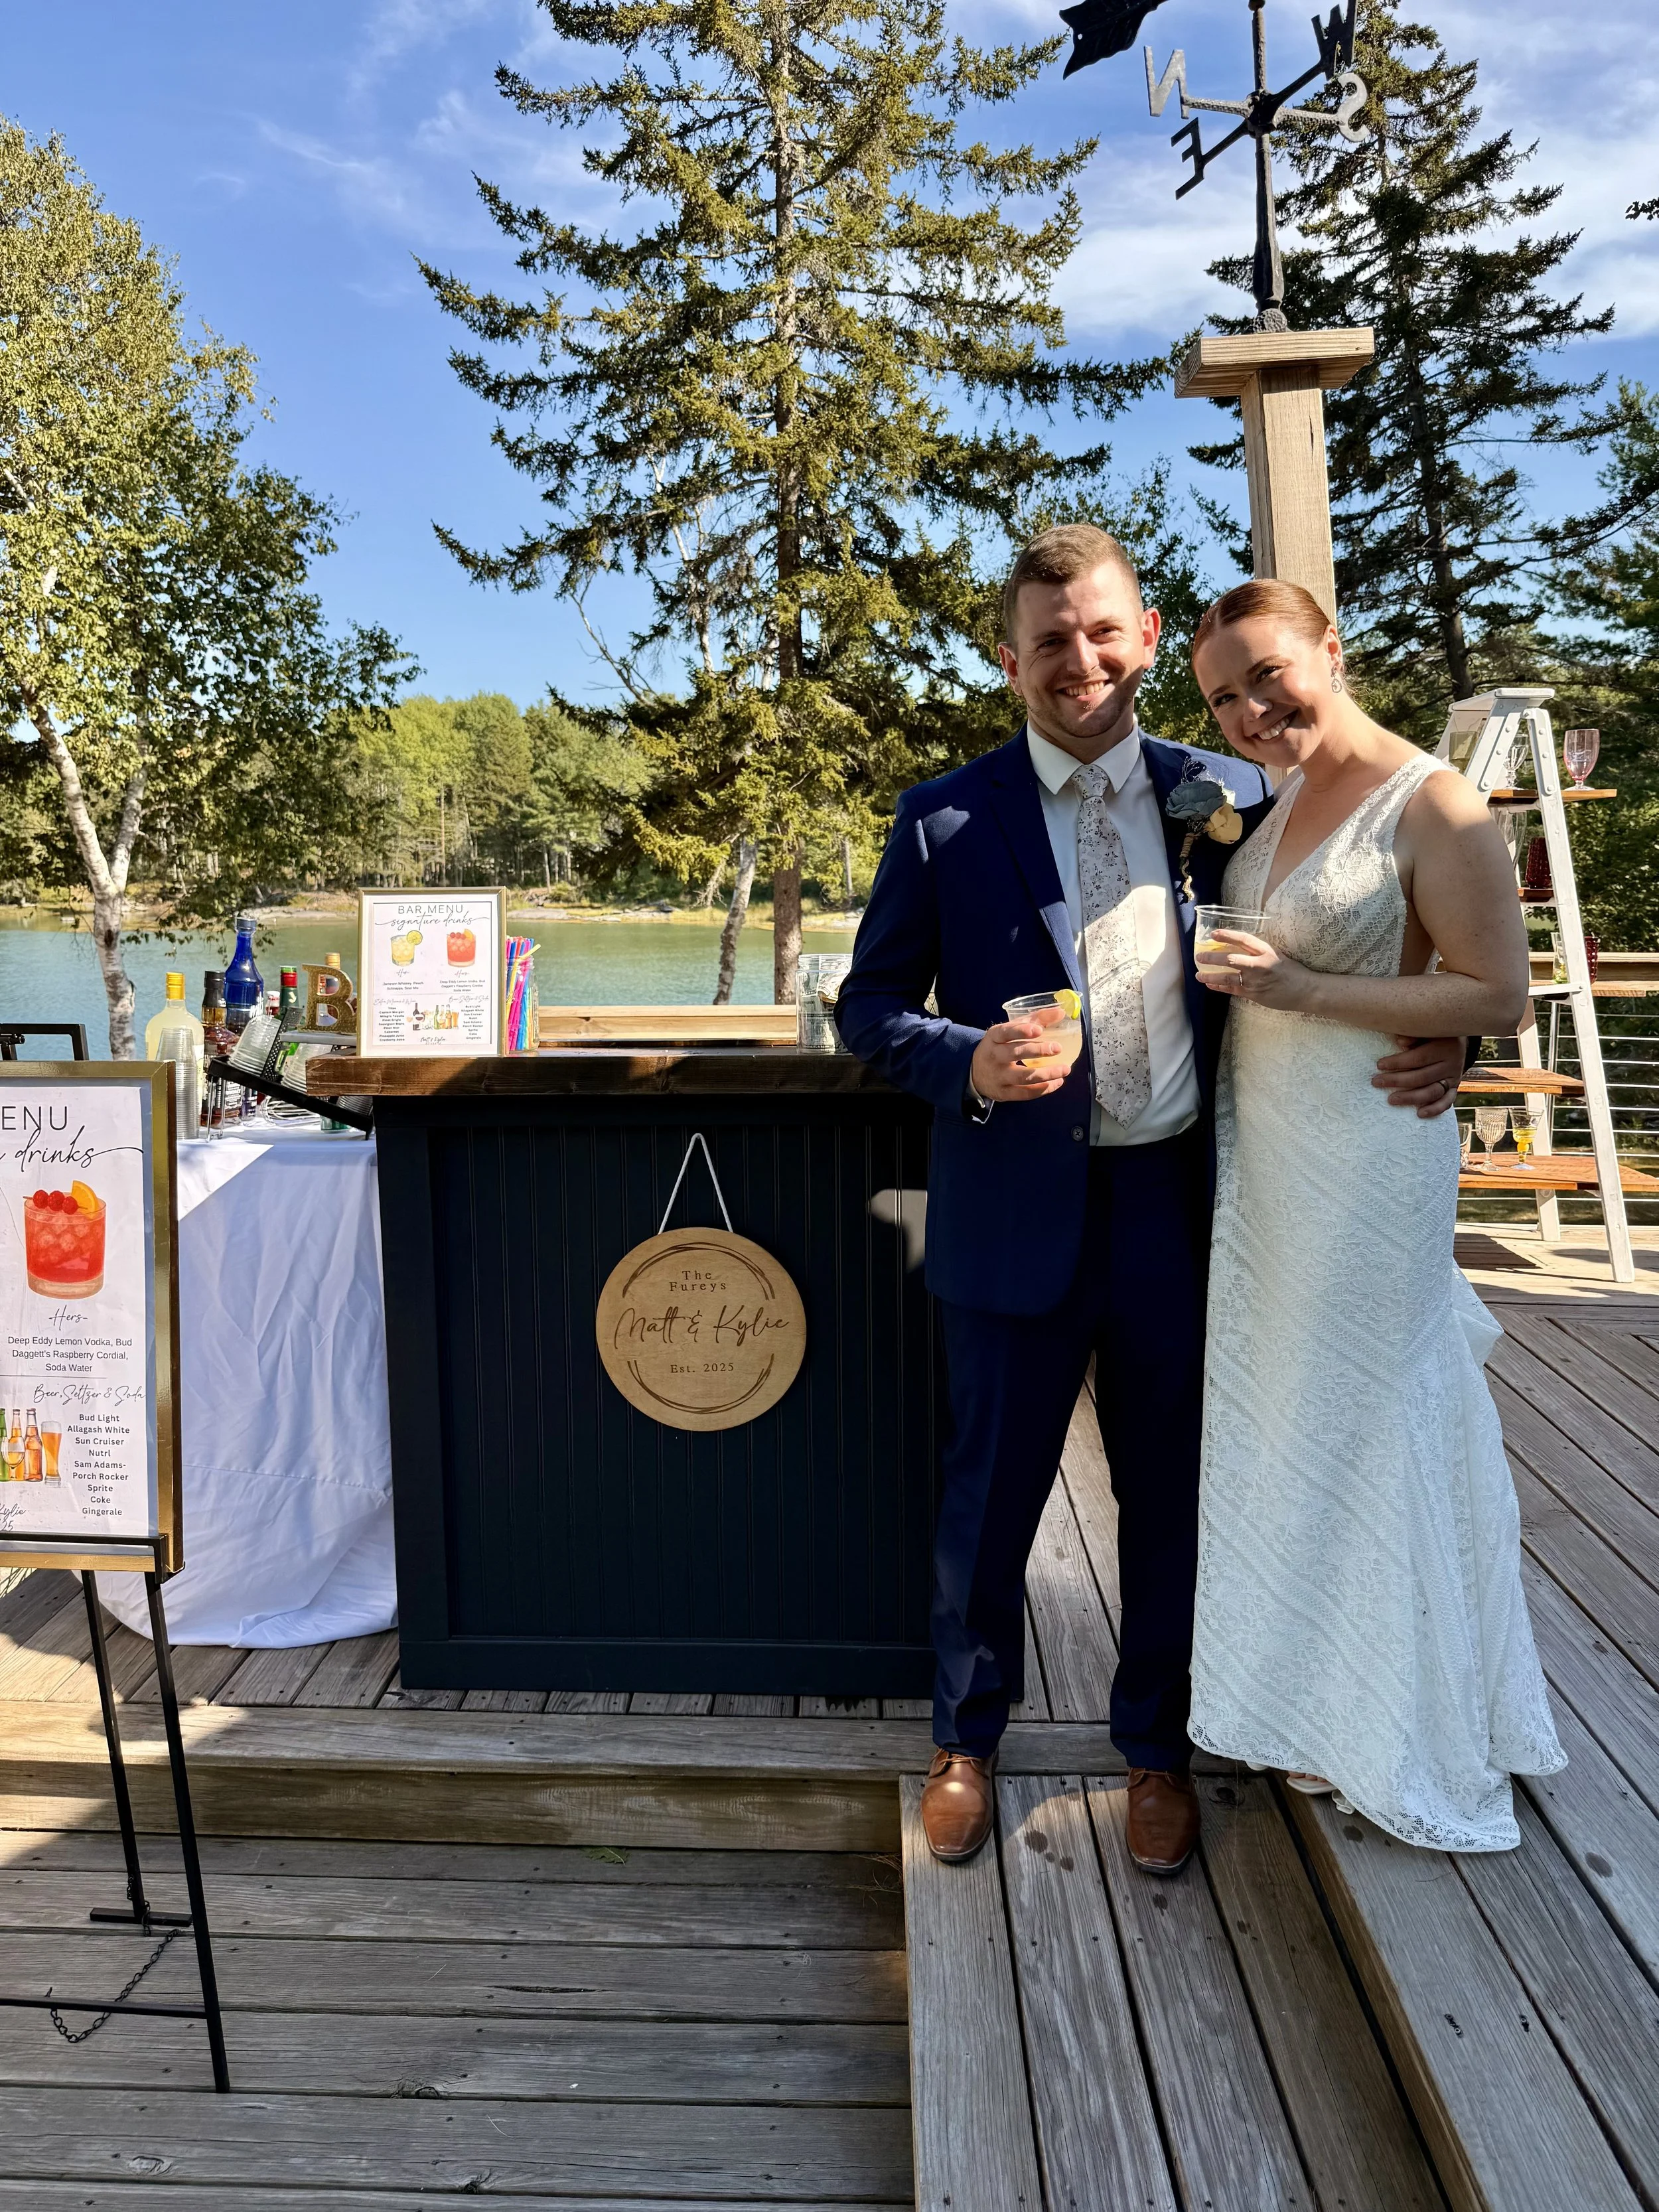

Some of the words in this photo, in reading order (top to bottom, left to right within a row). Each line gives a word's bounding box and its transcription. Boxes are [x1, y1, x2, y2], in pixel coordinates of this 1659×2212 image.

[398, 905, 421, 914] BAR
[428, 905, 463, 913] MENU
[375, 911, 440, 930] signature
[443, 911, 490, 926] drinks
[1, 1106, 68, 1130] ENU
[15, 1125, 143, 1173] drinks
[682, 1270, 713, 1280] The
[669, 1282, 727, 1291] Fureys
[614, 1306, 691, 1349] Matt
[687, 1309, 703, 1343] &
[713, 1305, 790, 1347] Kylie
[8, 1336, 30, 1347] Deep
[32, 1337, 53, 1347] Eddy
[84, 1337, 113, 1347] Vodka,
[12, 1349, 50, 1360] Daggett's
[53, 1350, 94, 1361] Raspberry
[96, 1351, 128, 1361] Cordial,
[45, 1363, 66, 1372] Soda
[68, 1363, 93, 1372] Water
[670, 1364, 695, 1373] Est.
[703, 1363, 734, 1372] 2025
[33, 1384, 62, 1404] Beer,
[62, 1384, 102, 1406] Seltzer
[103, 1388, 112, 1398] &
[115, 1385, 145, 1406] Soda
[98, 1414, 120, 1424] Light
[67, 1425, 102, 1435] Allagash
[88, 1449, 111, 1457] Nutrl
[94, 1461, 126, 1469] Adams-
[88, 1484, 113, 1493] Sprite
[82, 1507, 122, 1517] Gingerale
